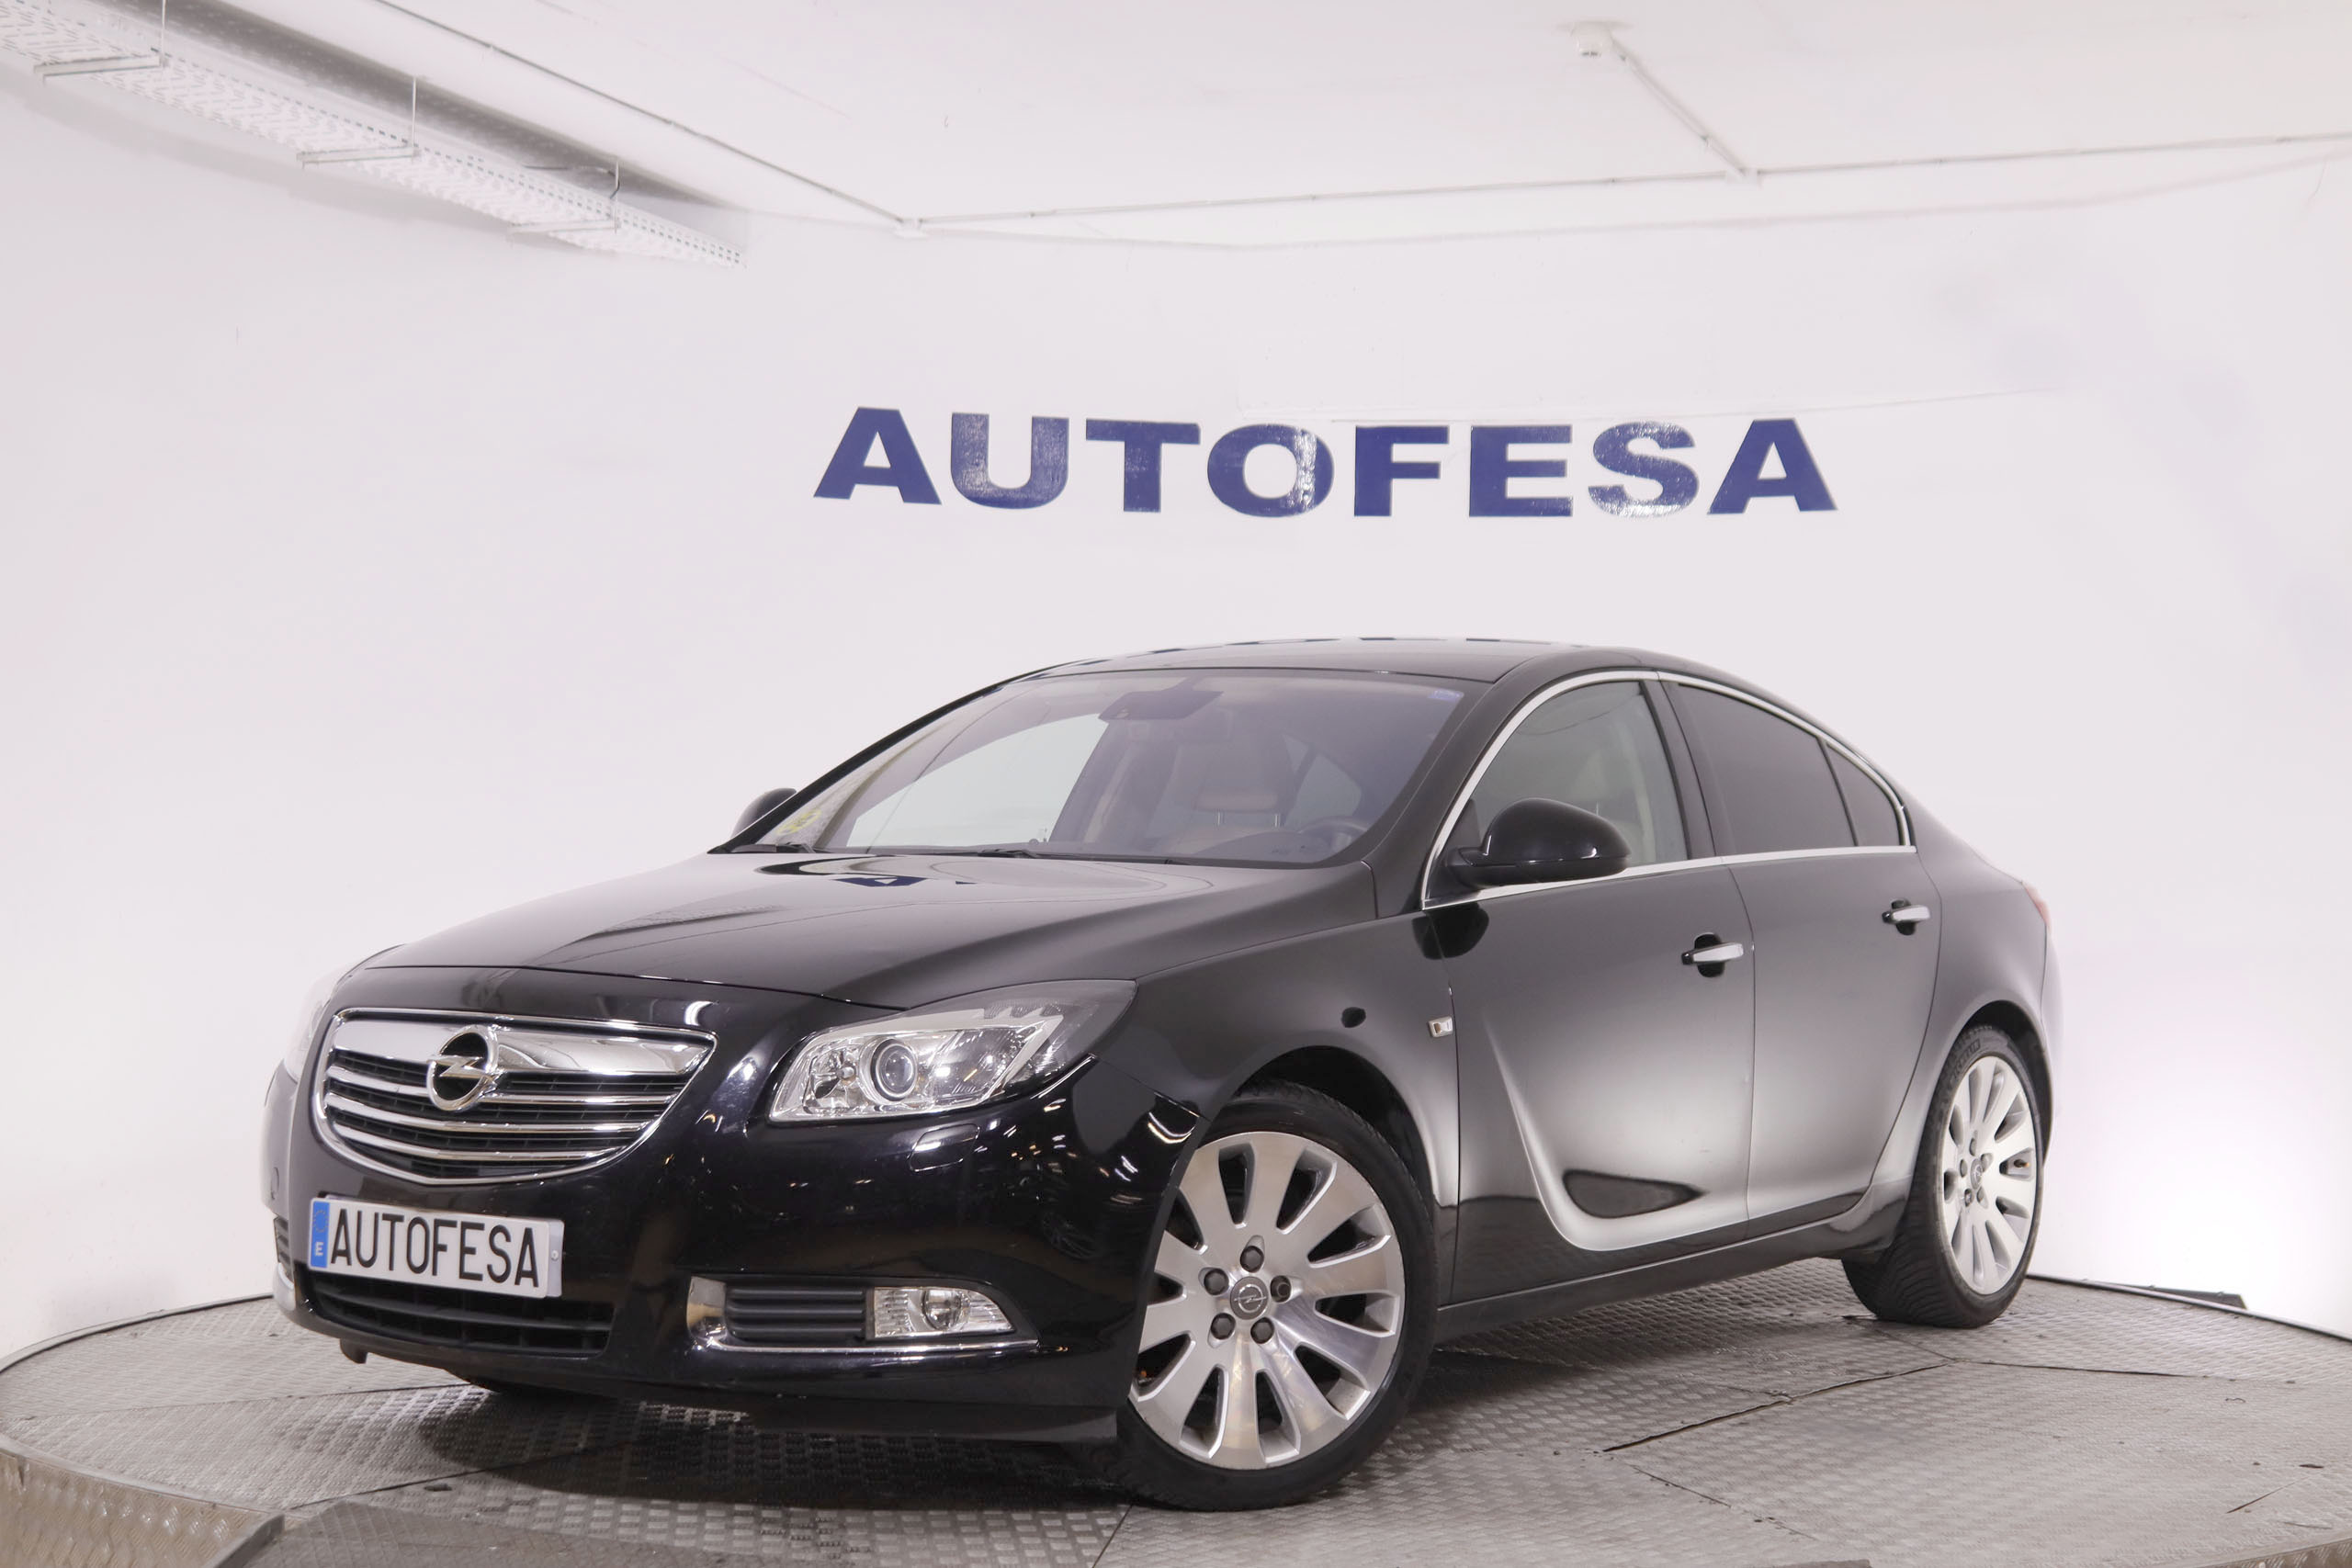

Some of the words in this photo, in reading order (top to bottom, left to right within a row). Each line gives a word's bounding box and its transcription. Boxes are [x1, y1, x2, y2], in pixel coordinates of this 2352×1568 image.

[814, 407, 1837, 518] AUTOFESA
[314, 1241, 324, 1257] E
[331, 1208, 539, 1288] AUTOFESA
